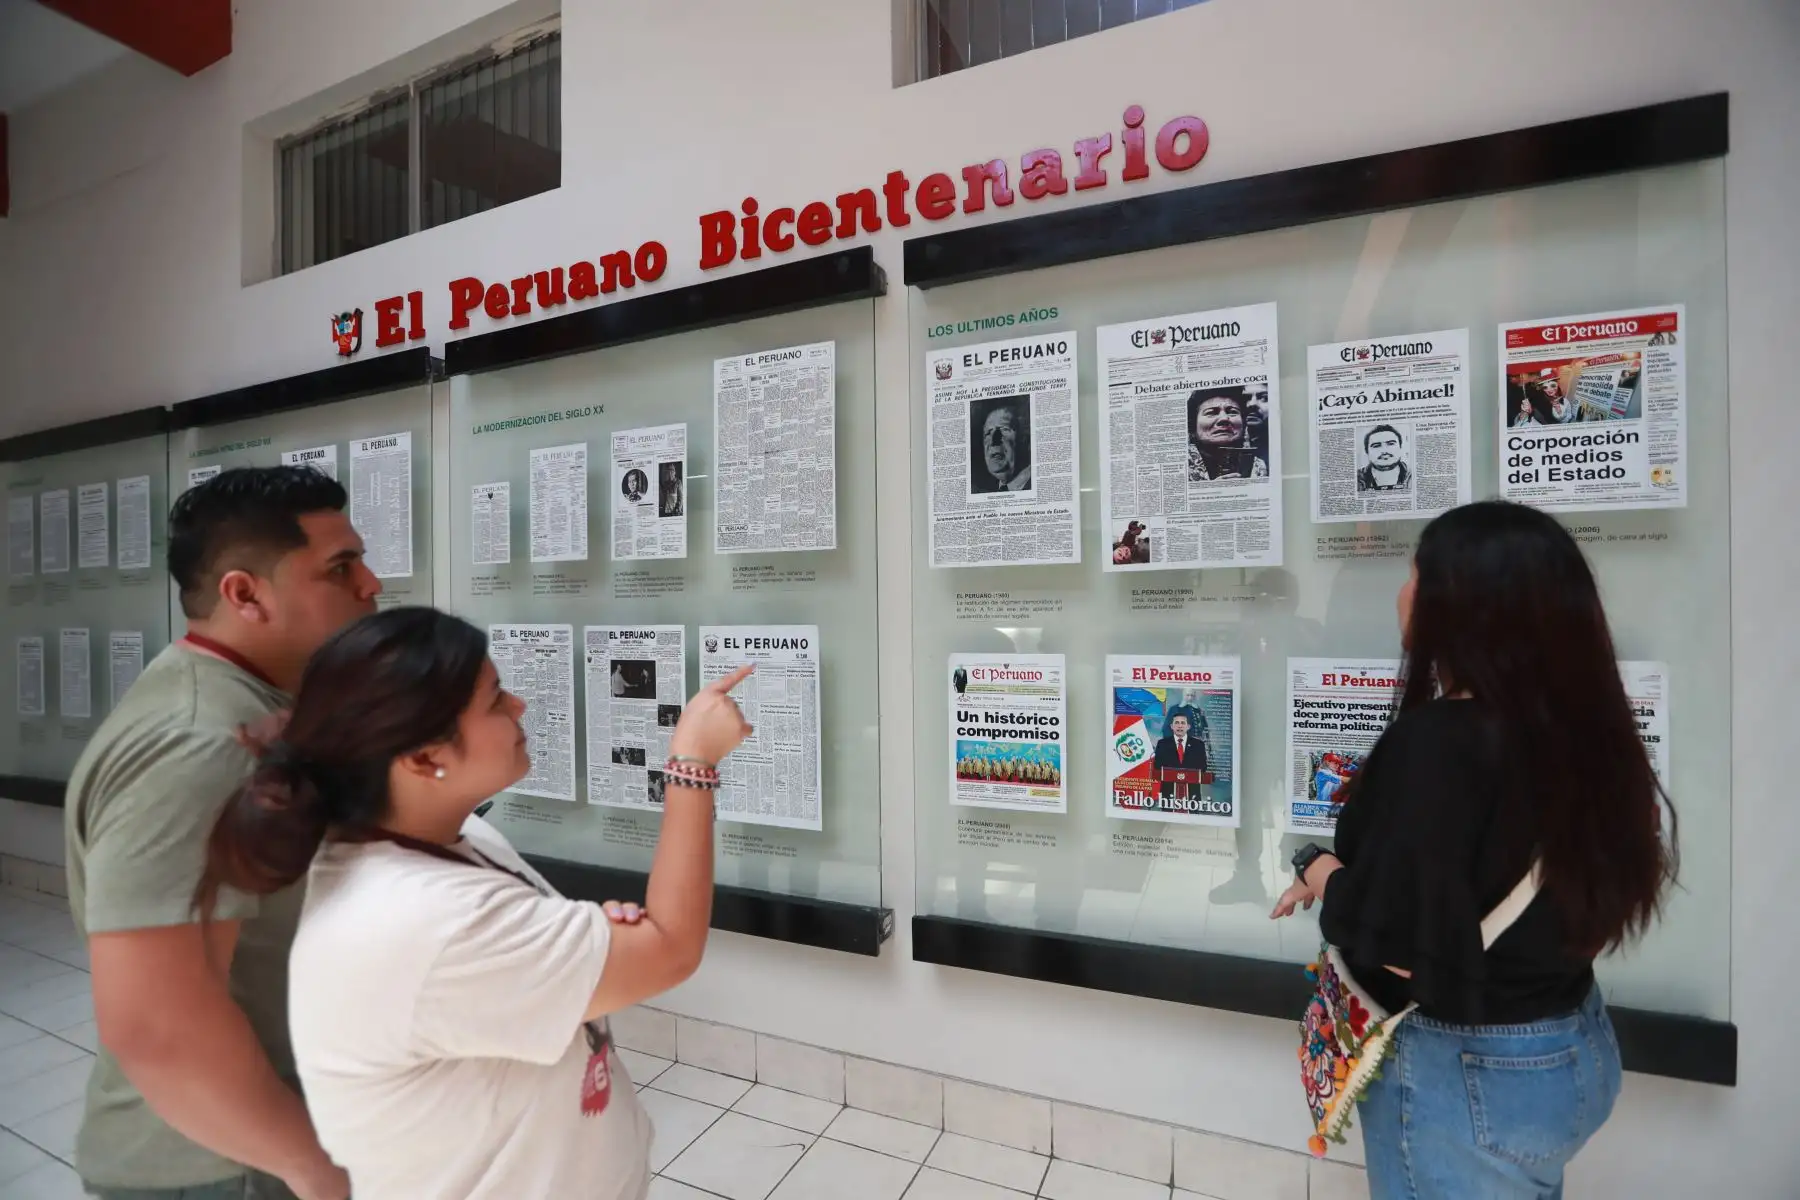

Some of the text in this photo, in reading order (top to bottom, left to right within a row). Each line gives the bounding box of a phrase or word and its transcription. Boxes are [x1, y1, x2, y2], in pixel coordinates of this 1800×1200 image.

[375, 105, 1210, 348] El Peruano Bicentenario
[928, 307, 1058, 338] LOS ULTIMOS AÑOS
[1131, 321, 1240, 350] El Peruano
[1541, 321, 1638, 342] El Peruano
[745, 350, 801, 366] EL PERUANO
[963, 341, 1068, 367] EL PERUANO
[1341, 341, 1432, 363] El Peruano
[1135, 374, 1268, 395] Debate abierto sobre coca
[1319, 383, 1454, 410] ¡Cayó Abimael!
[1589, 387, 1612, 399] debate
[473, 404, 605, 434] LA MODERNIZACION DEL SIGLO XX
[362, 442, 368, 450] EL
[1508, 429, 1639, 452] Corporación
[292, 454, 299, 462] EL
[1508, 449, 1623, 467] de medios
[1508, 465, 1626, 484] del Estado
[510, 630, 550, 638] EL PERUANO
[609, 631, 655, 639] EL PERUANO
[724, 638, 809, 649] EL PERUANO
[972, 668, 1043, 682] El Peruano
[1132, 667, 1212, 682] El Peruano
[1322, 674, 1336, 686] El
[1293, 699, 1346, 710] Ejecutivo
[957, 711, 1059, 726] Un histórico
[1293, 709, 1319, 719] doce
[1320, 710, 1377, 722] proyectos
[957, 727, 1059, 740] compromiso
[1293, 720, 1383, 732] reforma política
[1114, 789, 1232, 813] Fallo histórico
[965, 820, 993, 828] PERUANO
[1123, 835, 1153, 843] PERUANO
